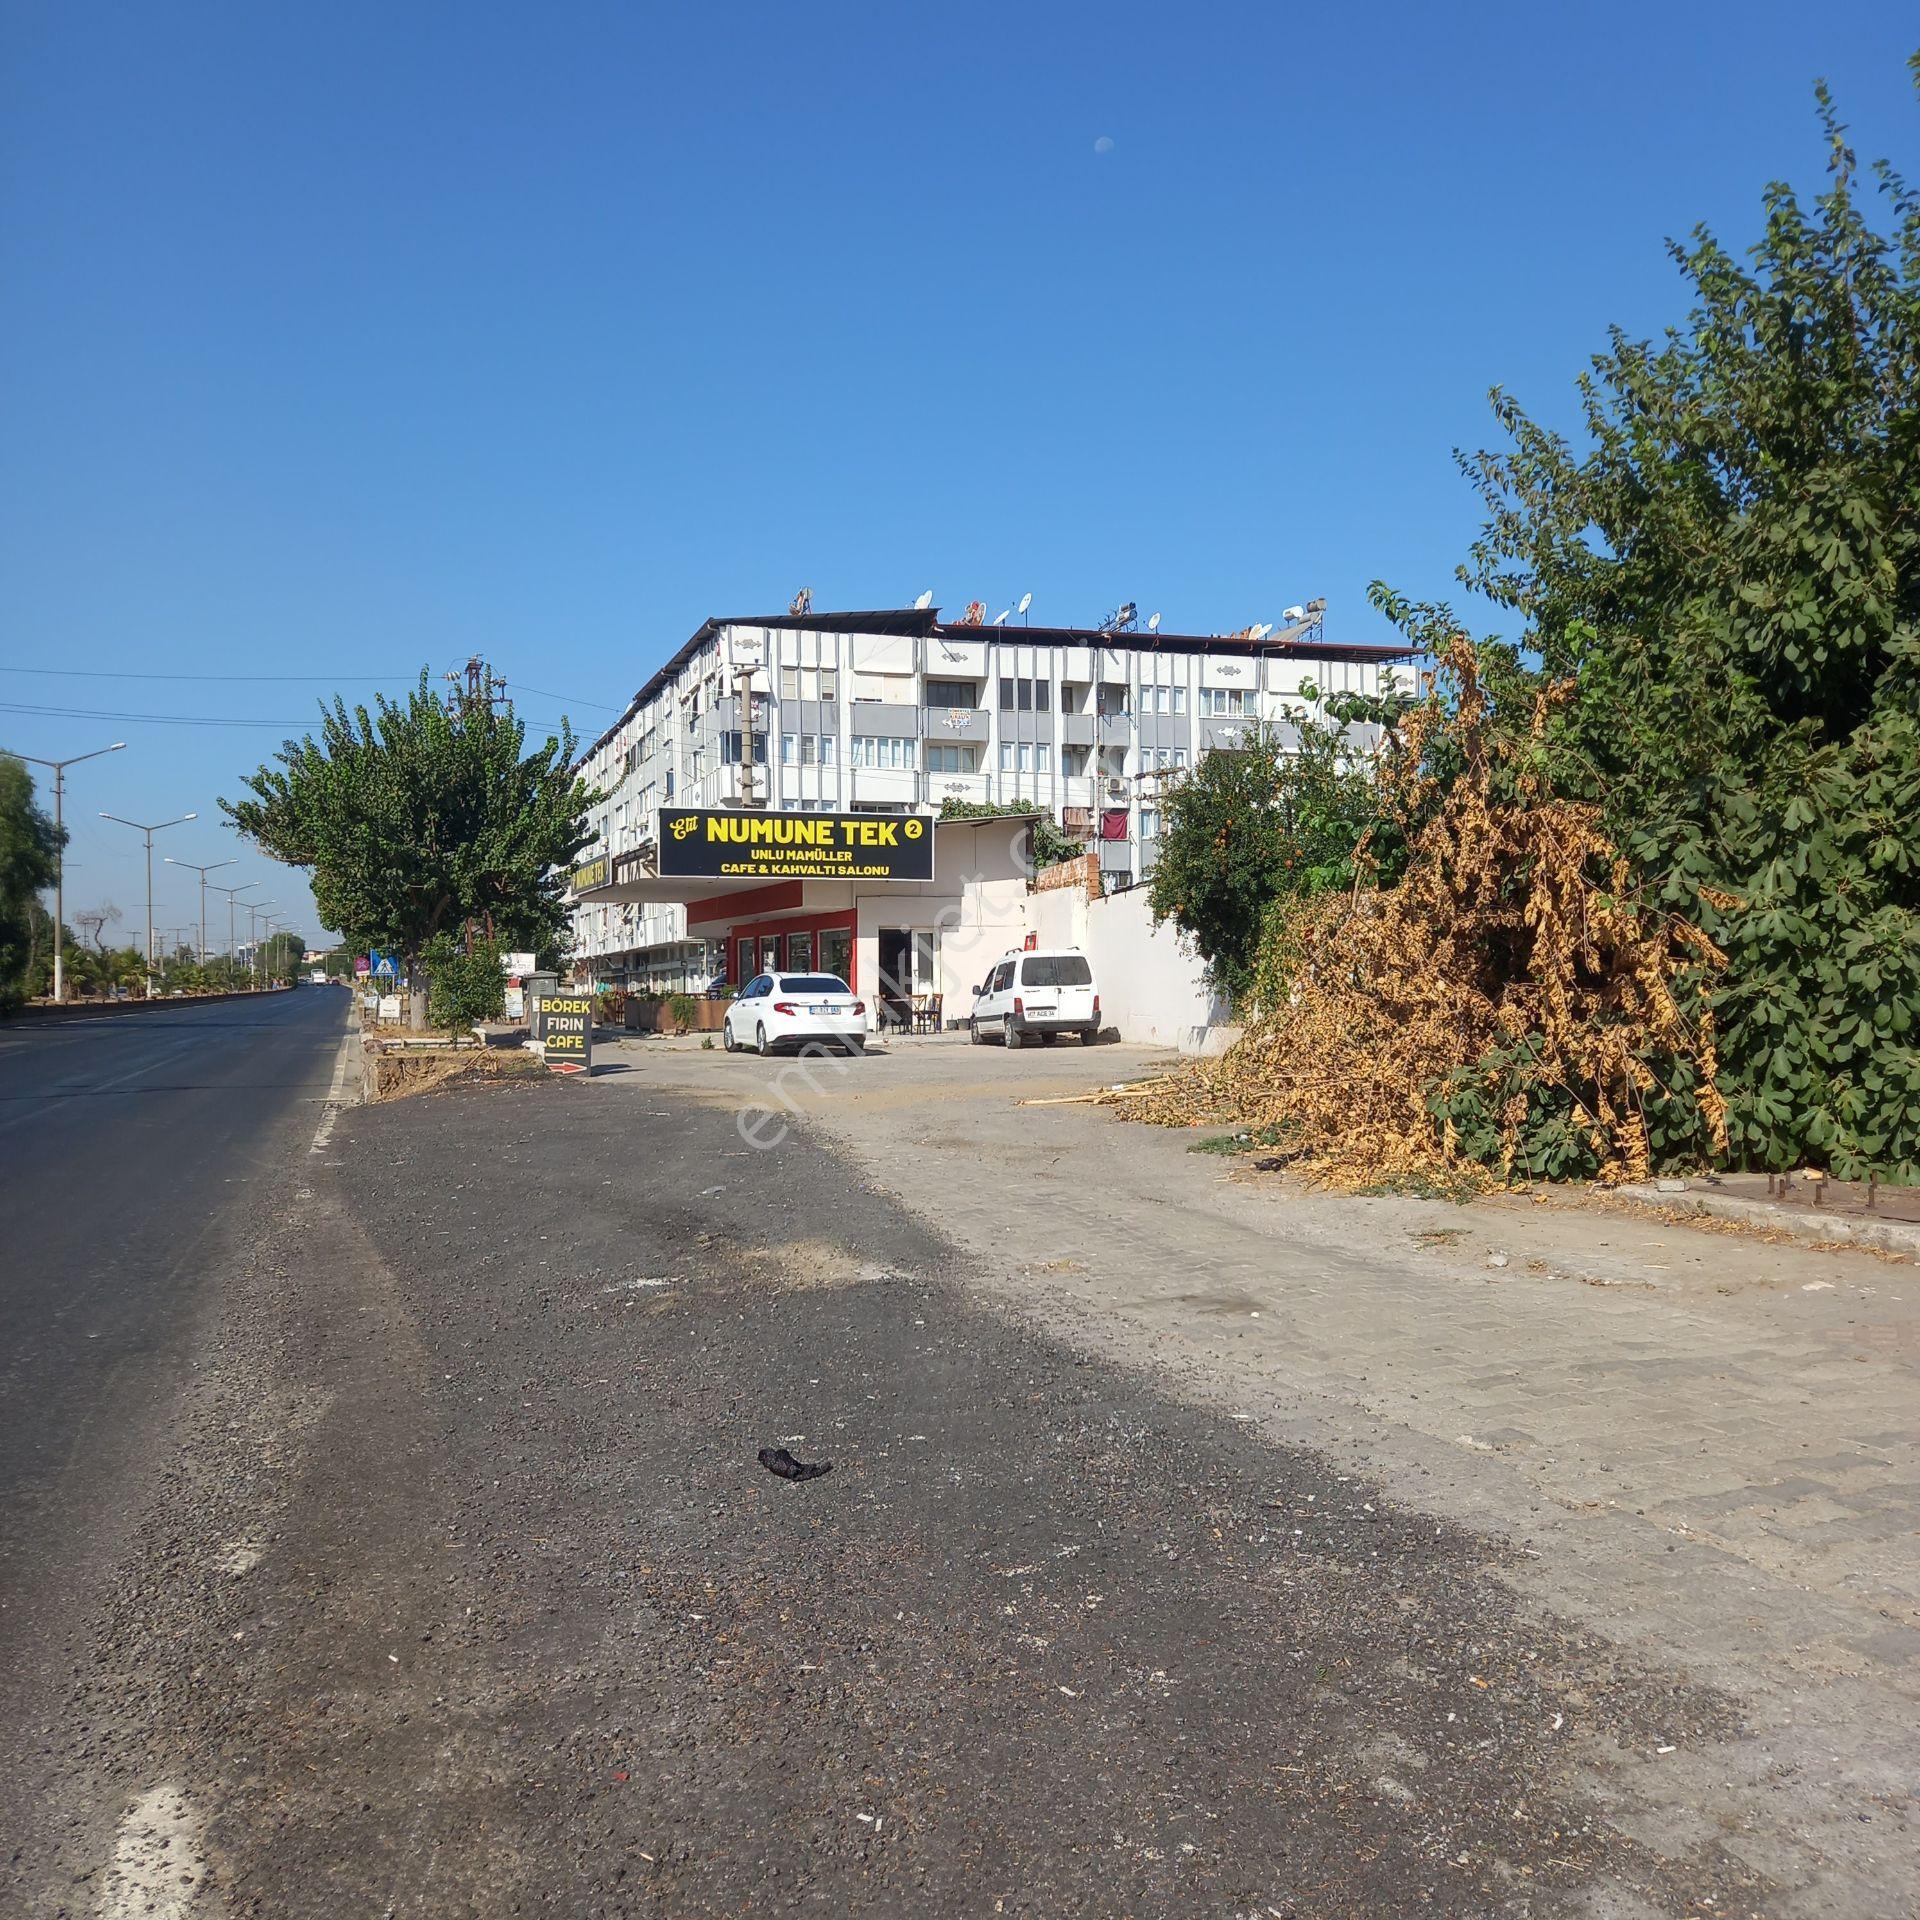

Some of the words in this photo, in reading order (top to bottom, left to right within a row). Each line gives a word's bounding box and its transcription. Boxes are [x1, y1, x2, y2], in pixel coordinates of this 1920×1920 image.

[707, 817, 834, 845] NUMUNE
[841, 821, 898, 846] TEK
[751, 849, 784, 860] UNLU
[786, 848, 852, 862] MAMÜLLER
[721, 863, 756, 874] CAFE
[759, 863, 769, 874] &
[771, 864, 835, 875] KAHVALTI
[838, 865, 890, 876] SALONU
[541, 998, 591, 1015] BÖREK
[547, 1017, 584, 1031] FIRIN
[546, 1035, 584, 1049] CAFE
